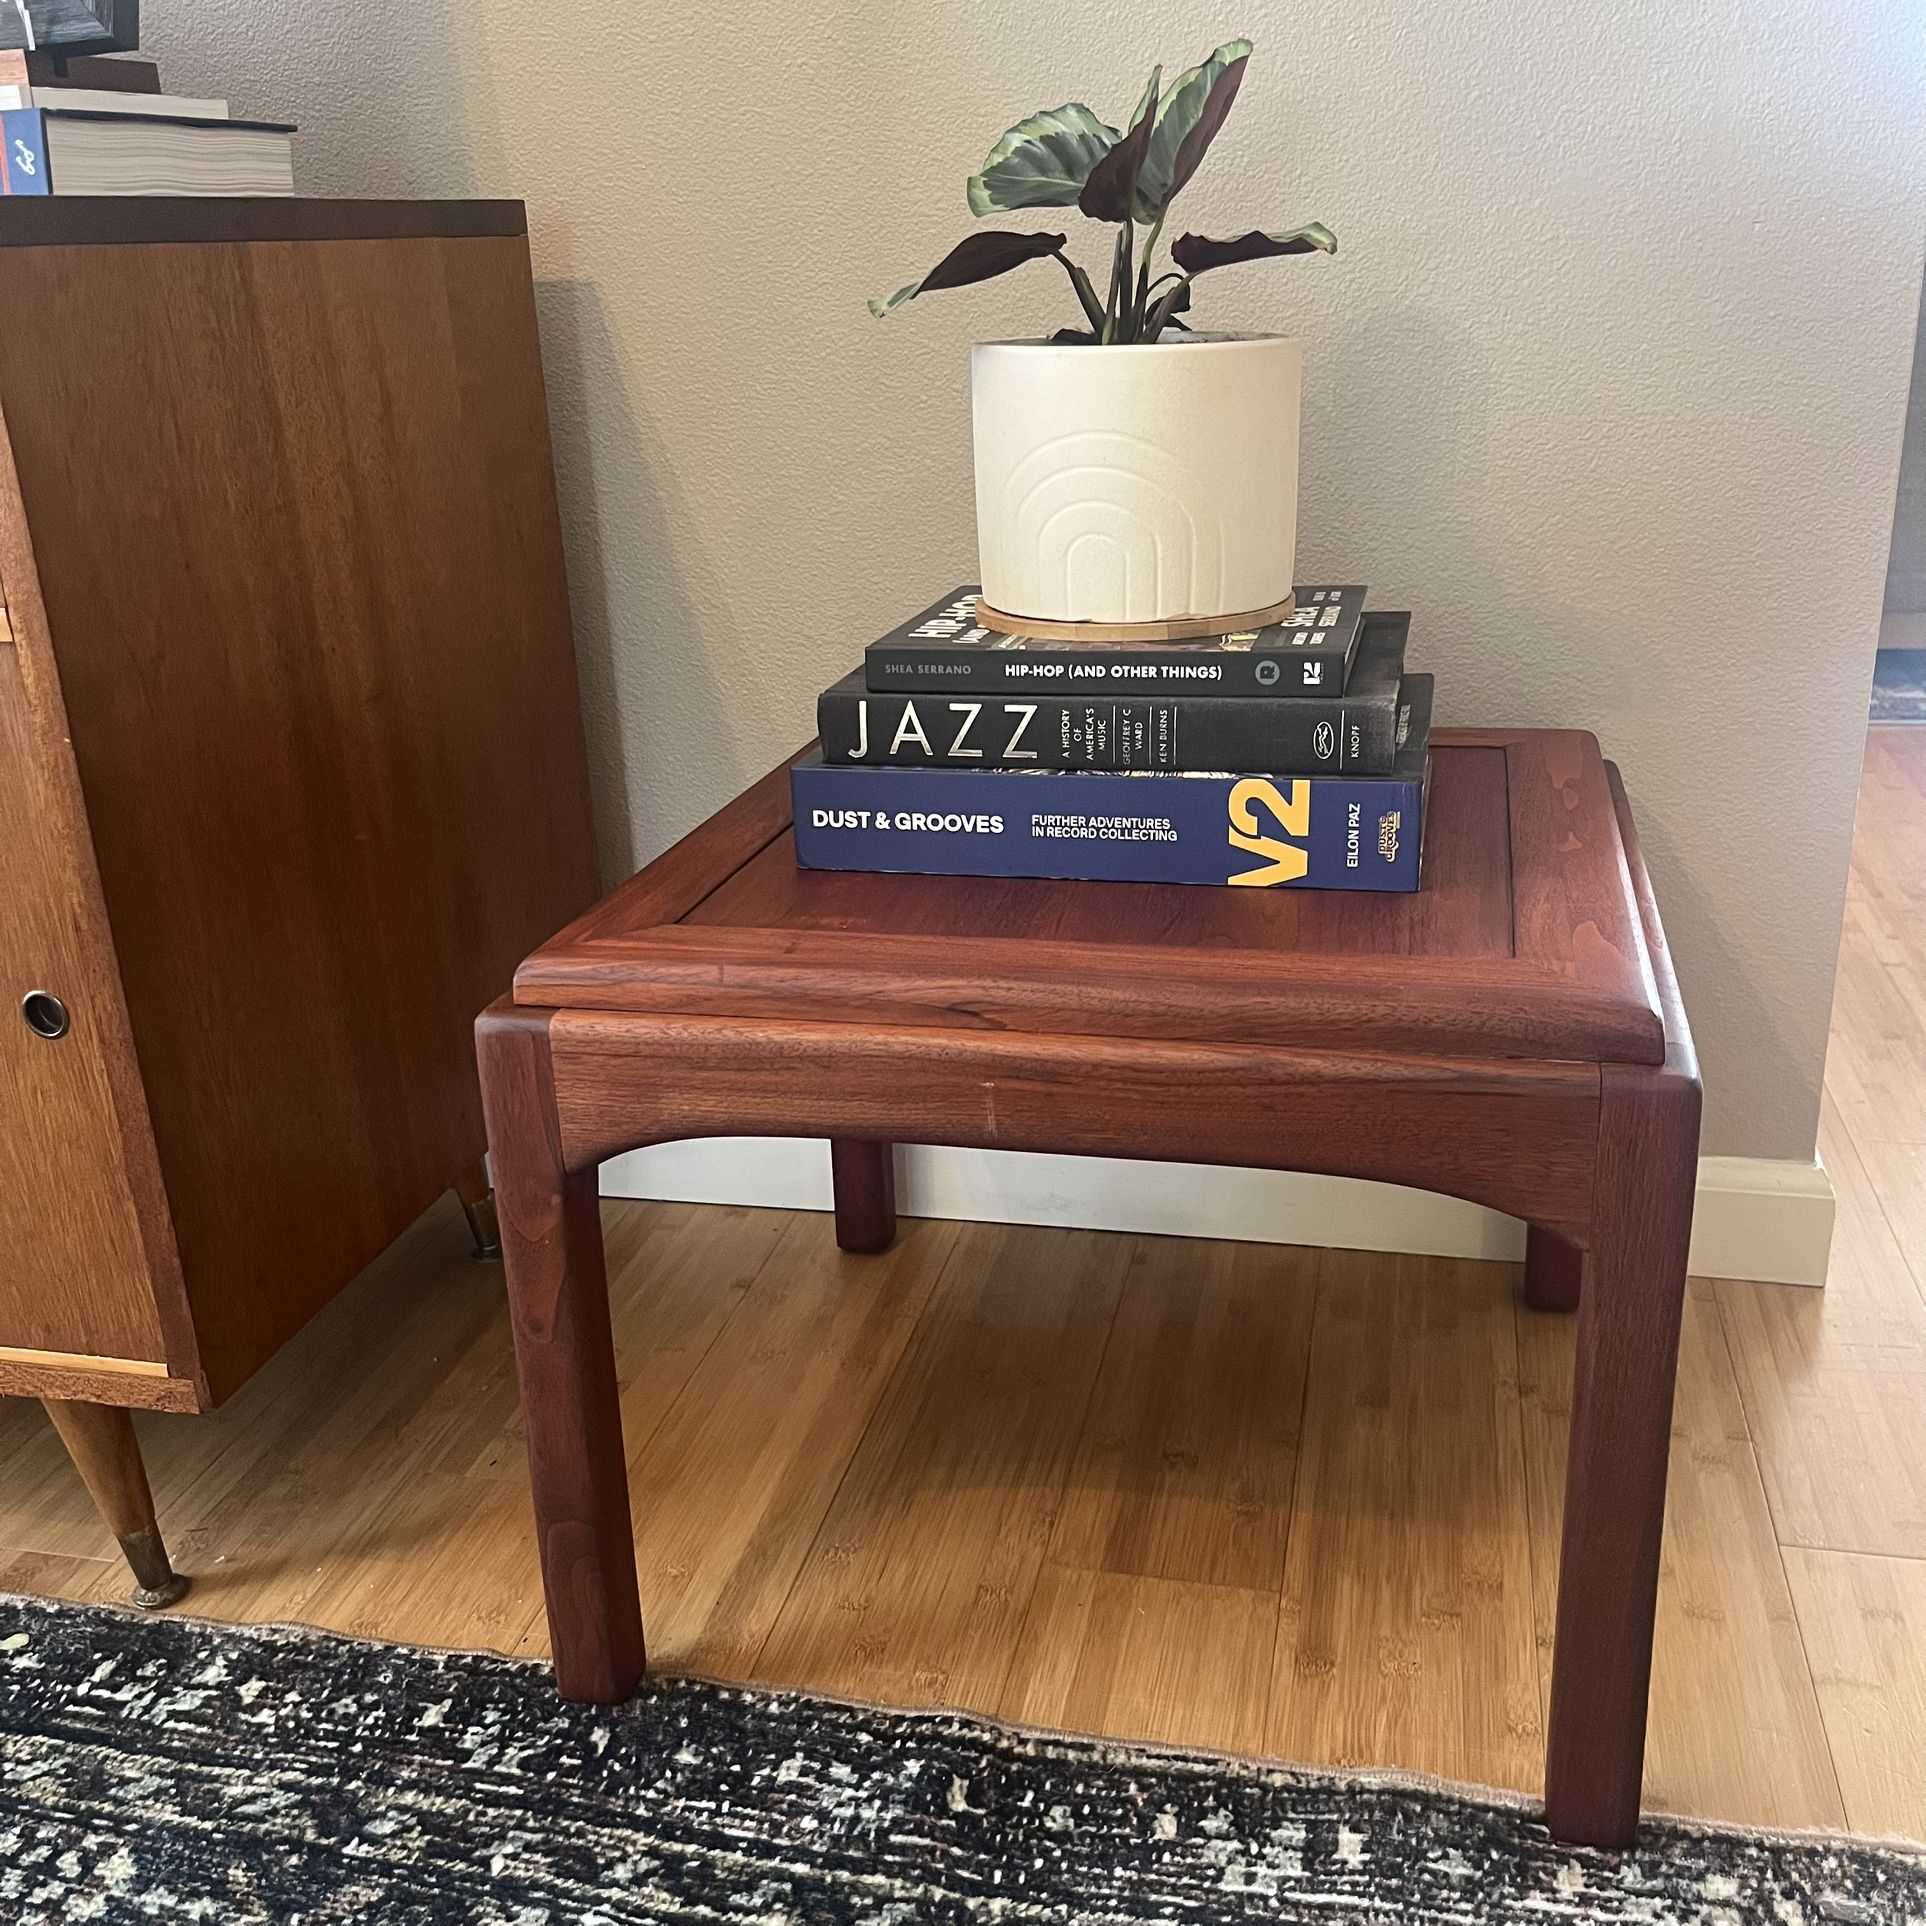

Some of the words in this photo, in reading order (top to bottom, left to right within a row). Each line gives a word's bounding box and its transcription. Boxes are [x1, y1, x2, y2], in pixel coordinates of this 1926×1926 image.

[885, 664, 914, 674] SHEA
[918, 664, 971, 675] SERRANO
[1005, 664, 1065, 678] HIP-HOP
[1068, 664, 1107, 680] (AND
[1110, 665, 1158, 678] OTHER
[1160, 665, 1222, 681] THINGS)
[848, 700, 1038, 758] JAZZ
[1061, 709, 1070, 748] HISTORY
[1073, 728, 1082, 742] OF
[1085, 708, 1095, 760] AMERICA'S
[1097, 720, 1106, 751] MUSIC
[1135, 722, 1143, 750] WARD
[1159, 709, 1168, 741] BURNS
[1122, 719, 1131, 765] GEOFFREY
[1159, 743, 1167, 763] KEN
[1350, 725, 1360, 758] KNOPF
[812, 810, 871, 829] DUST
[874, 811, 891, 830] &
[894, 812, 1004, 834] GROOVES
[1031, 814, 1086, 827] FURTHER
[1088, 816, 1171, 829] ADVENTURES
[1348, 802, 1361, 828] PAZ
[1032, 826, 1045, 837] IN
[1046, 826, 1097, 839] RECORD
[1098, 828, 1178, 842] COLLECTING
[1227, 778, 1311, 887] V2
[1385, 811, 1399, 863] GROOVES
[1347, 829, 1359, 868] EILON
